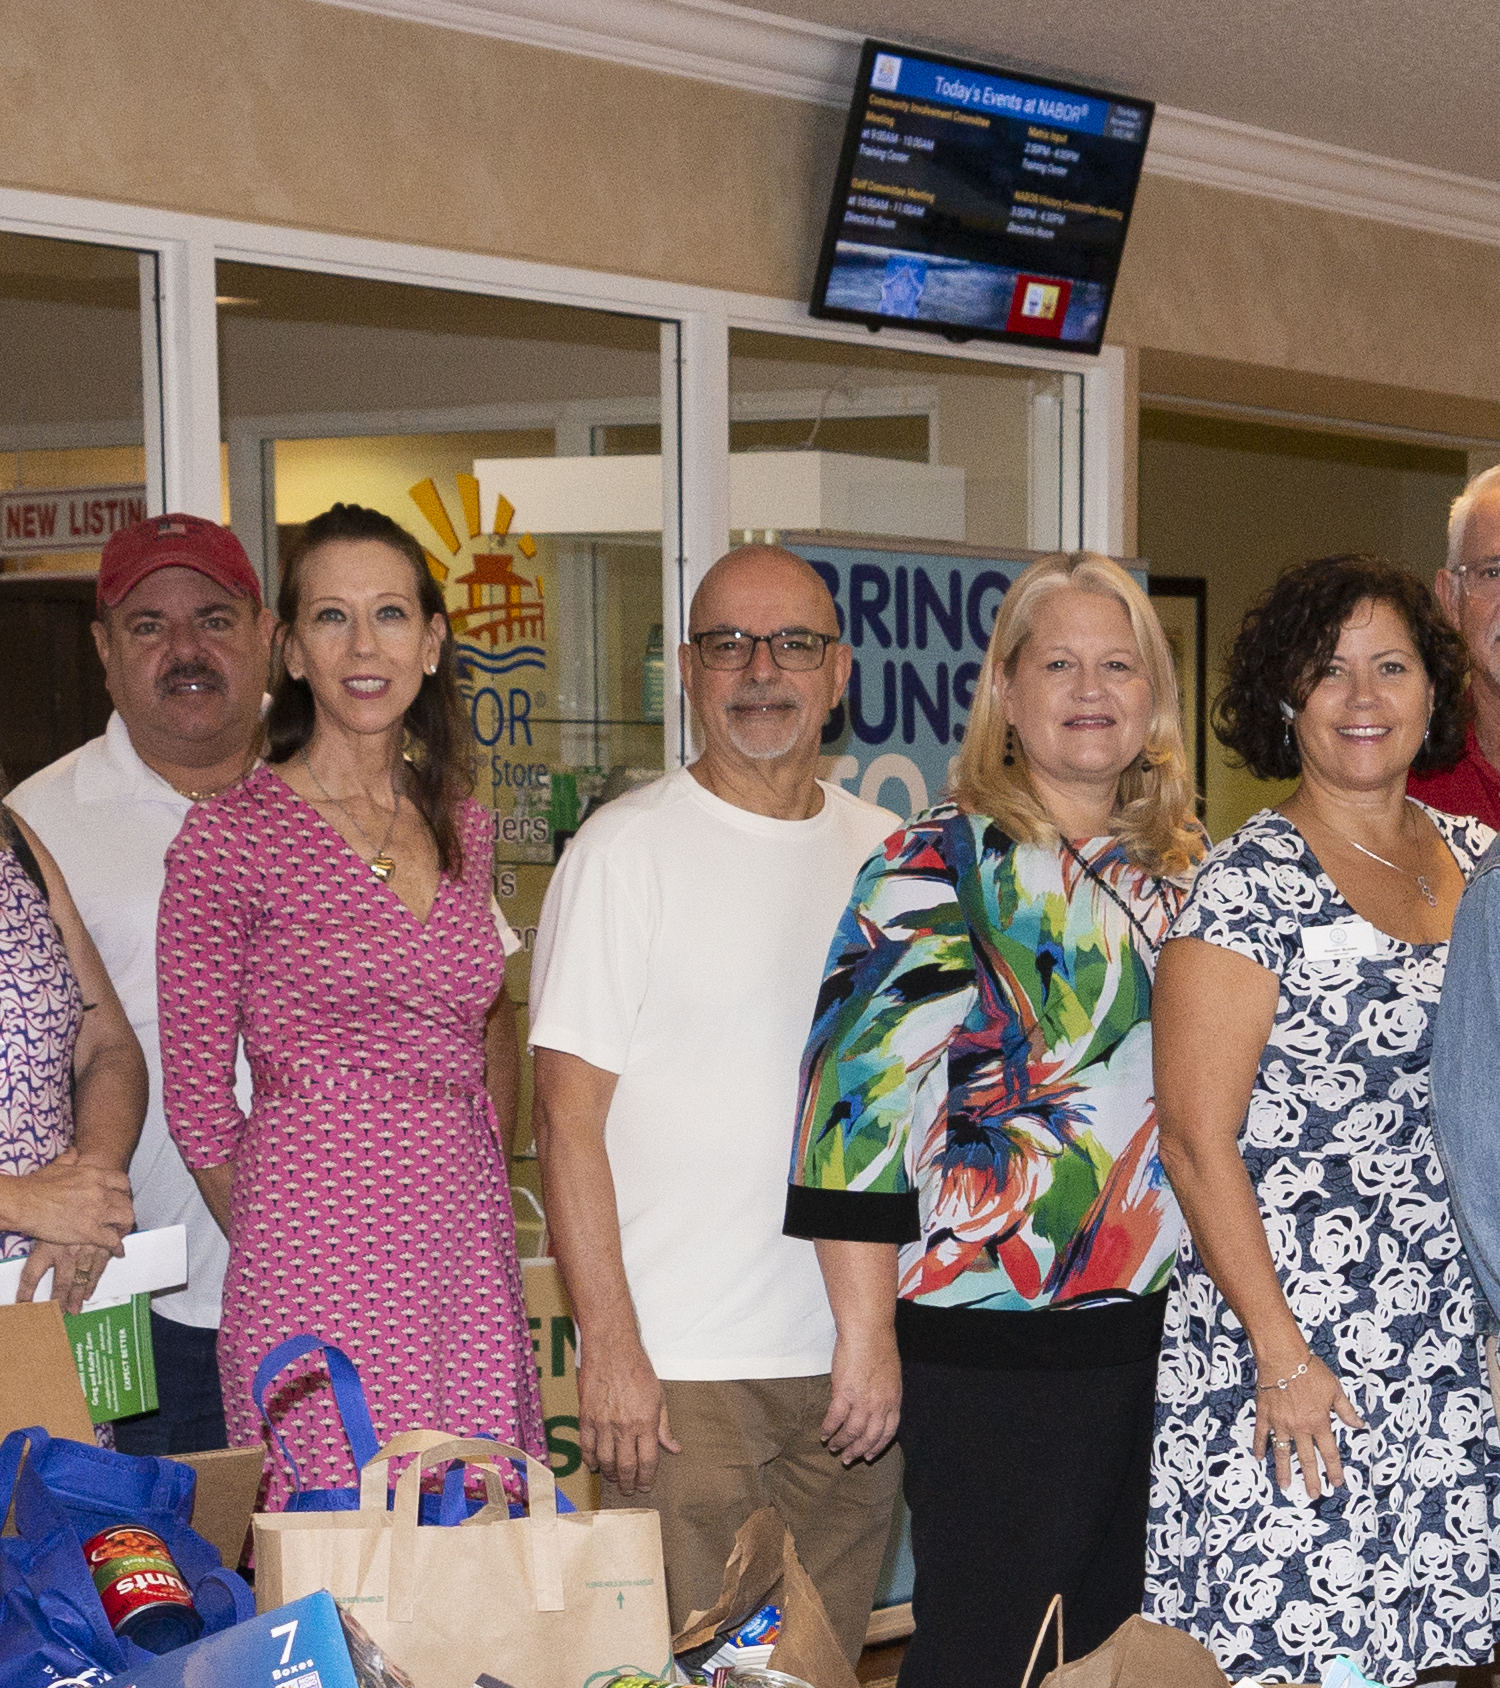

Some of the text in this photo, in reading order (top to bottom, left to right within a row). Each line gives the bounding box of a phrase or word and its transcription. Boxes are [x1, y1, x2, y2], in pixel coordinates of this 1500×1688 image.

[936, 75, 980, 104] Today's
[982, 86, 1022, 112] Events
[1023, 98, 1036, 114] at
[6, 506, 55, 536] NEW
[492, 755, 548, 786] Store
[270, 1619, 298, 1665] 7
[271, 1659, 314, 1681] Boxes
